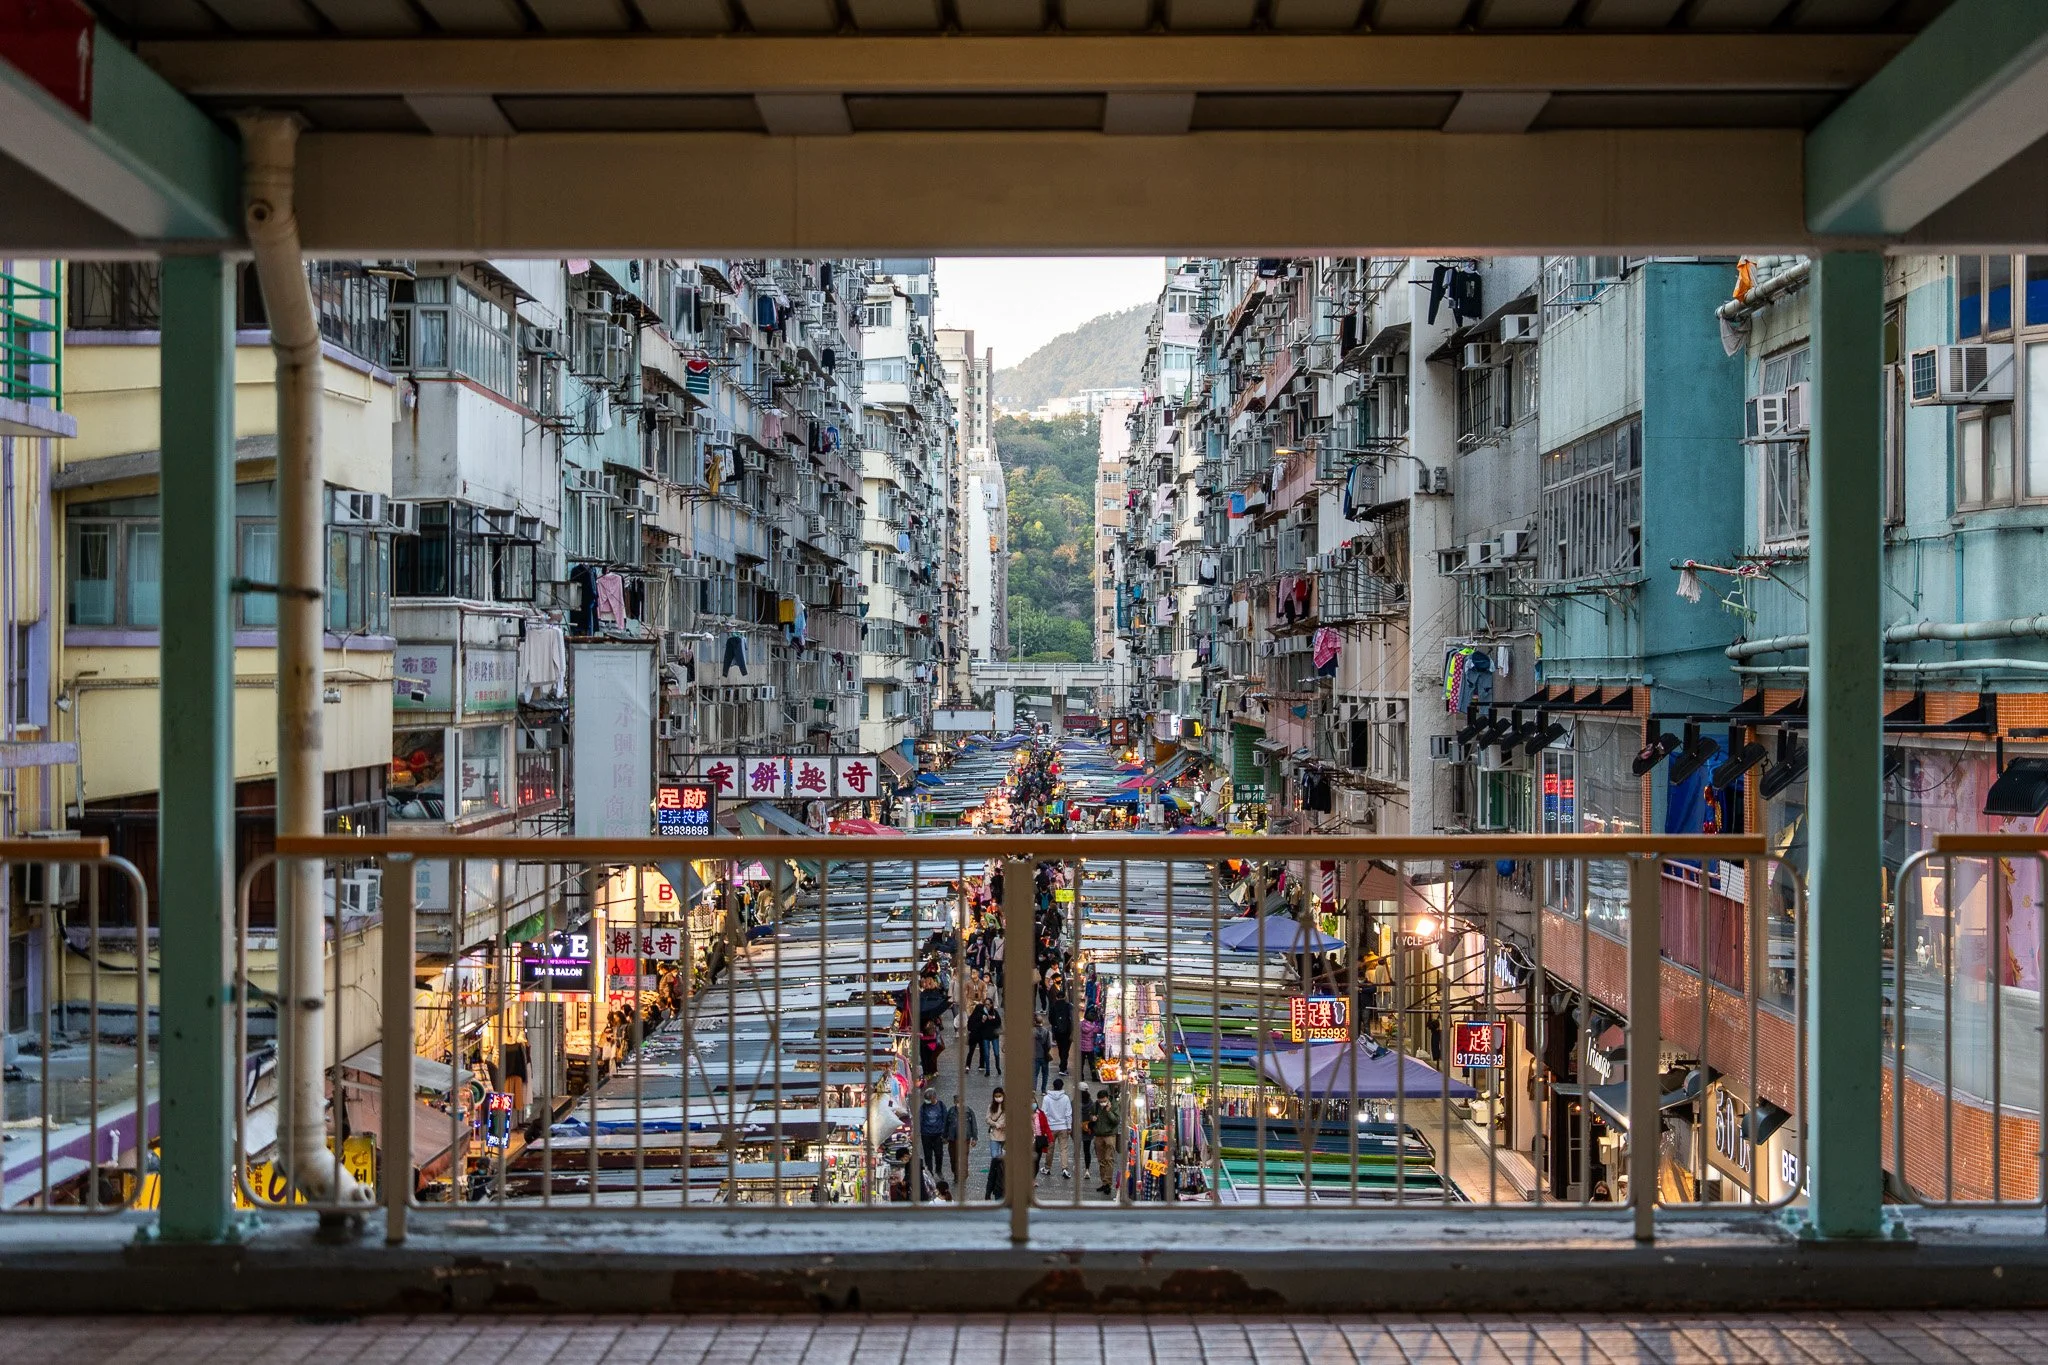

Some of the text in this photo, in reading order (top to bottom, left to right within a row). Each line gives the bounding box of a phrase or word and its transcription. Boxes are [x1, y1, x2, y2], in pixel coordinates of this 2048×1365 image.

[658, 788, 706, 809] 足跡
[662, 825, 709, 836] 23938698
[659, 884, 673, 901] B
[555, 968, 582, 976] SALON
